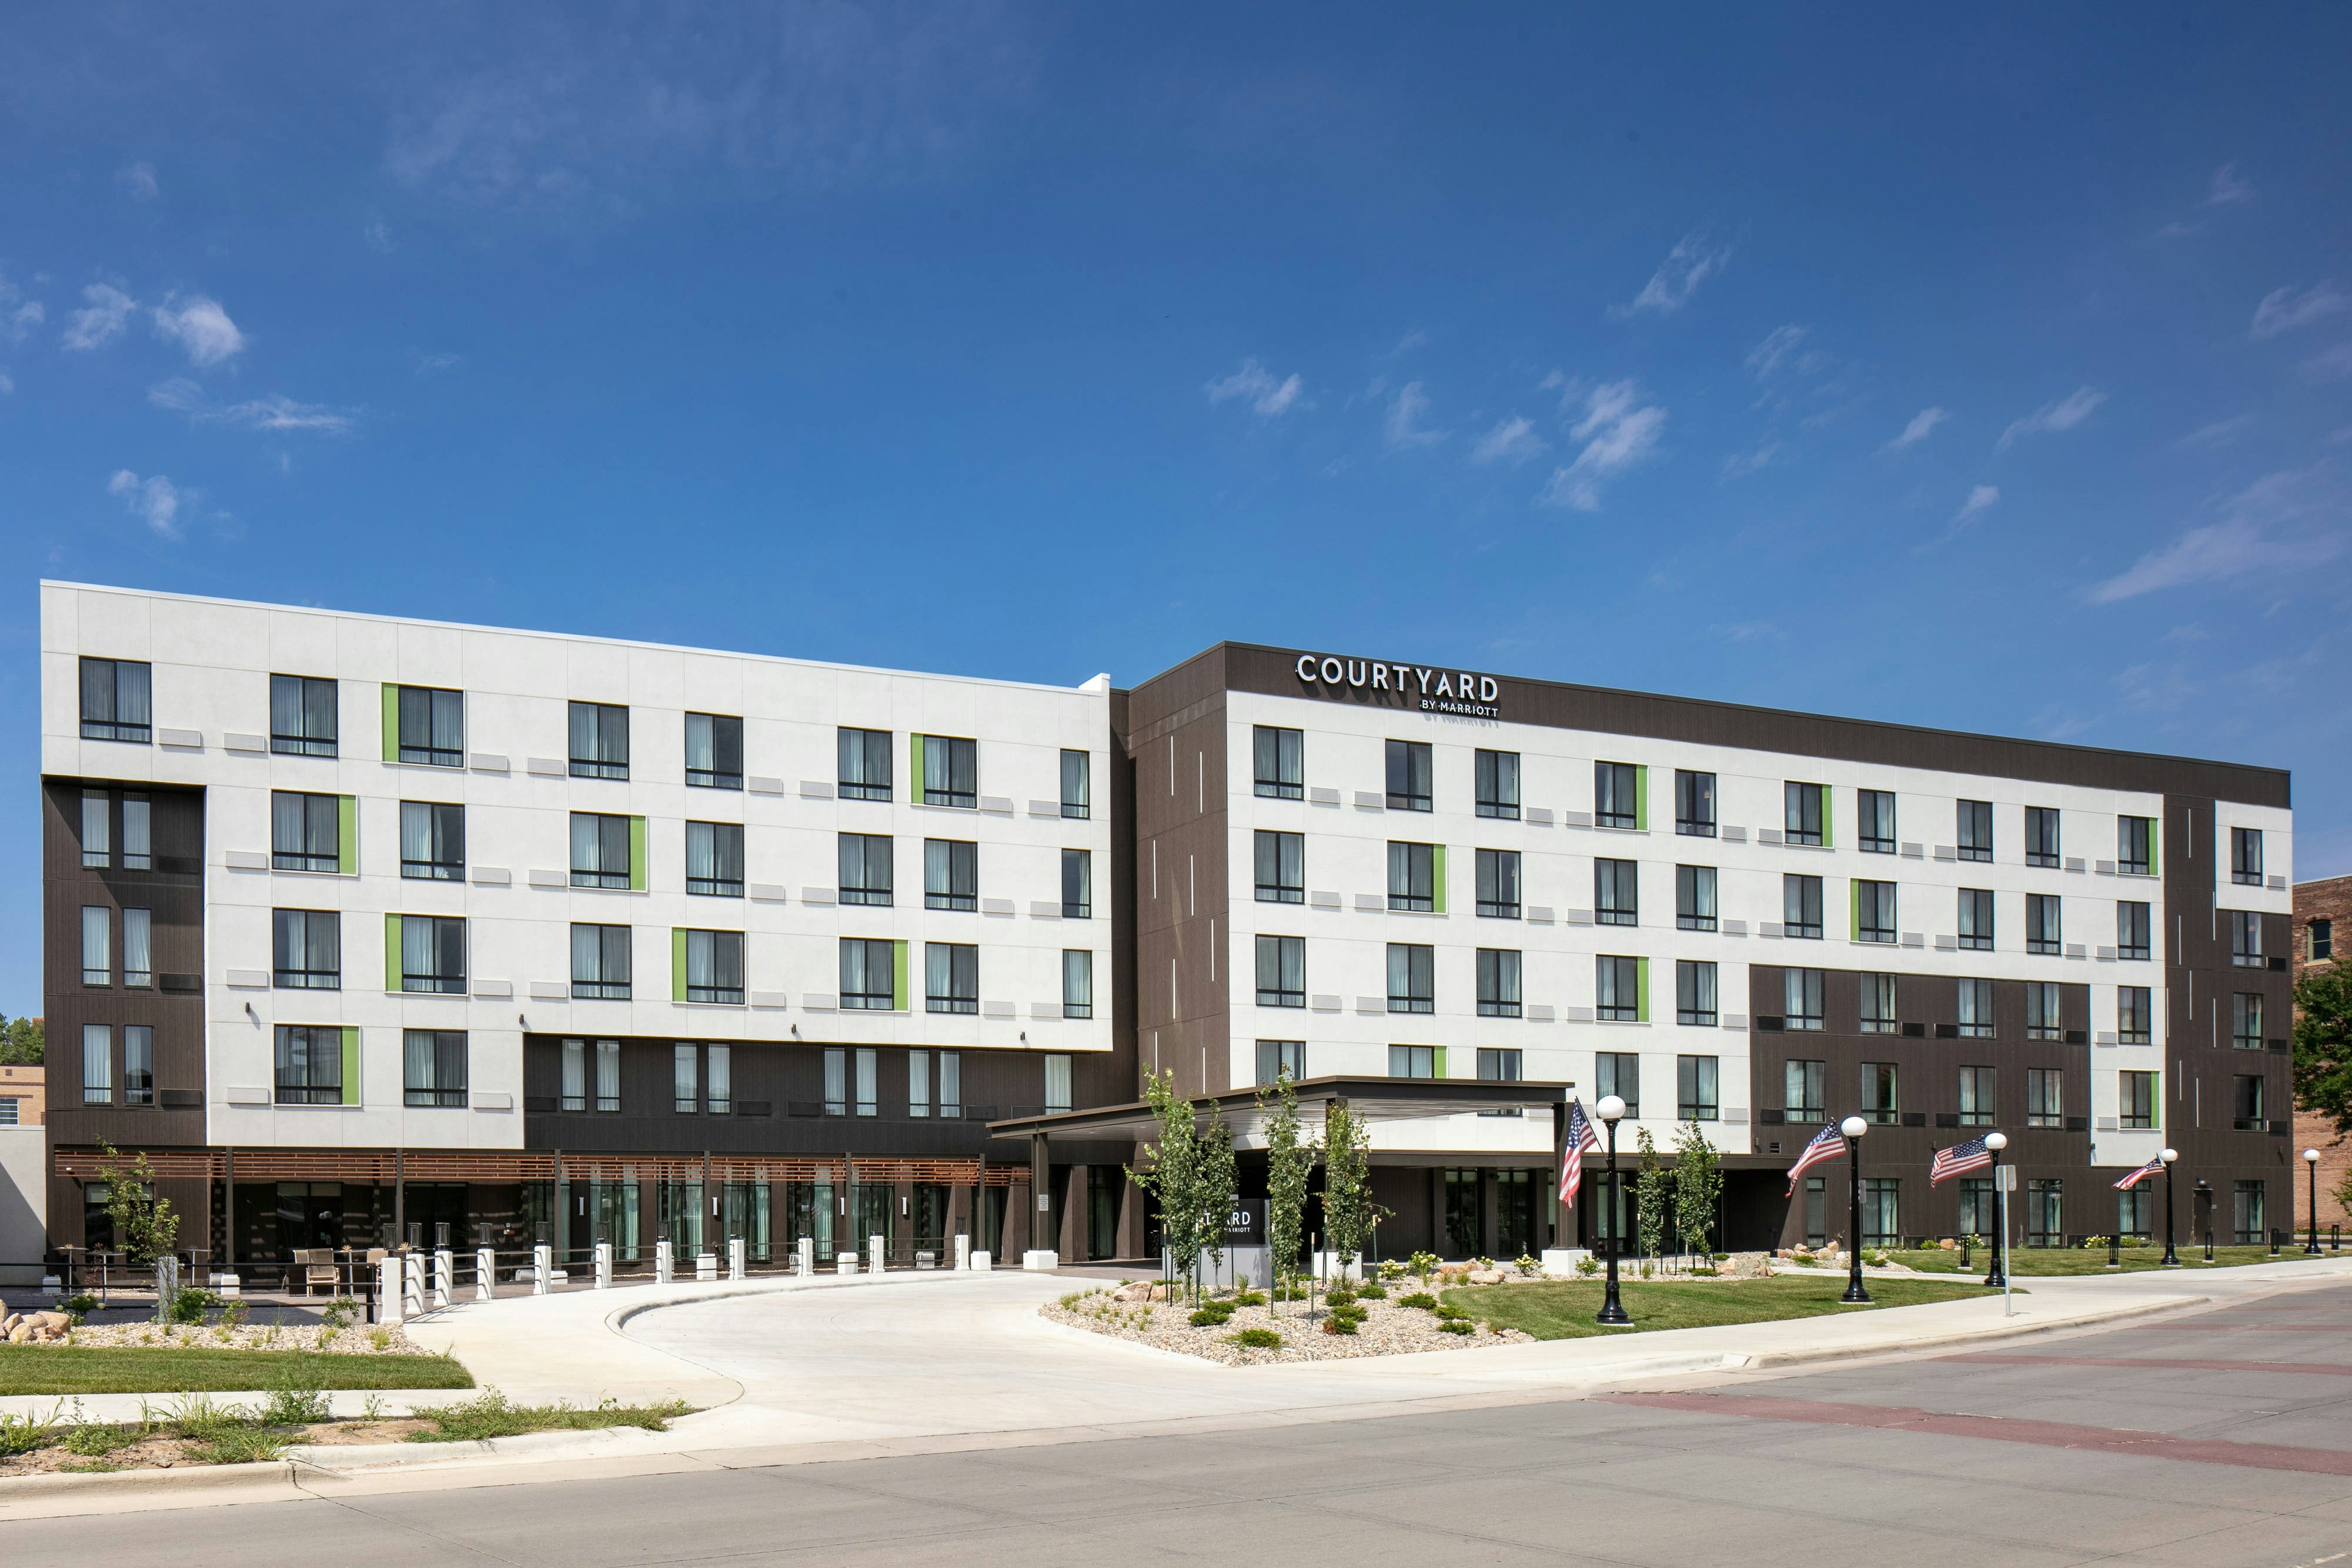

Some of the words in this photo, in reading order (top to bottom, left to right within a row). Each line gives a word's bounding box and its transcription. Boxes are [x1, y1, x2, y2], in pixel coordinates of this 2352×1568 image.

[1297, 654, 1498, 701] COURTYARD
[1422, 700, 1435, 710] BY
[1440, 701, 1498, 717] MARRIOTT
